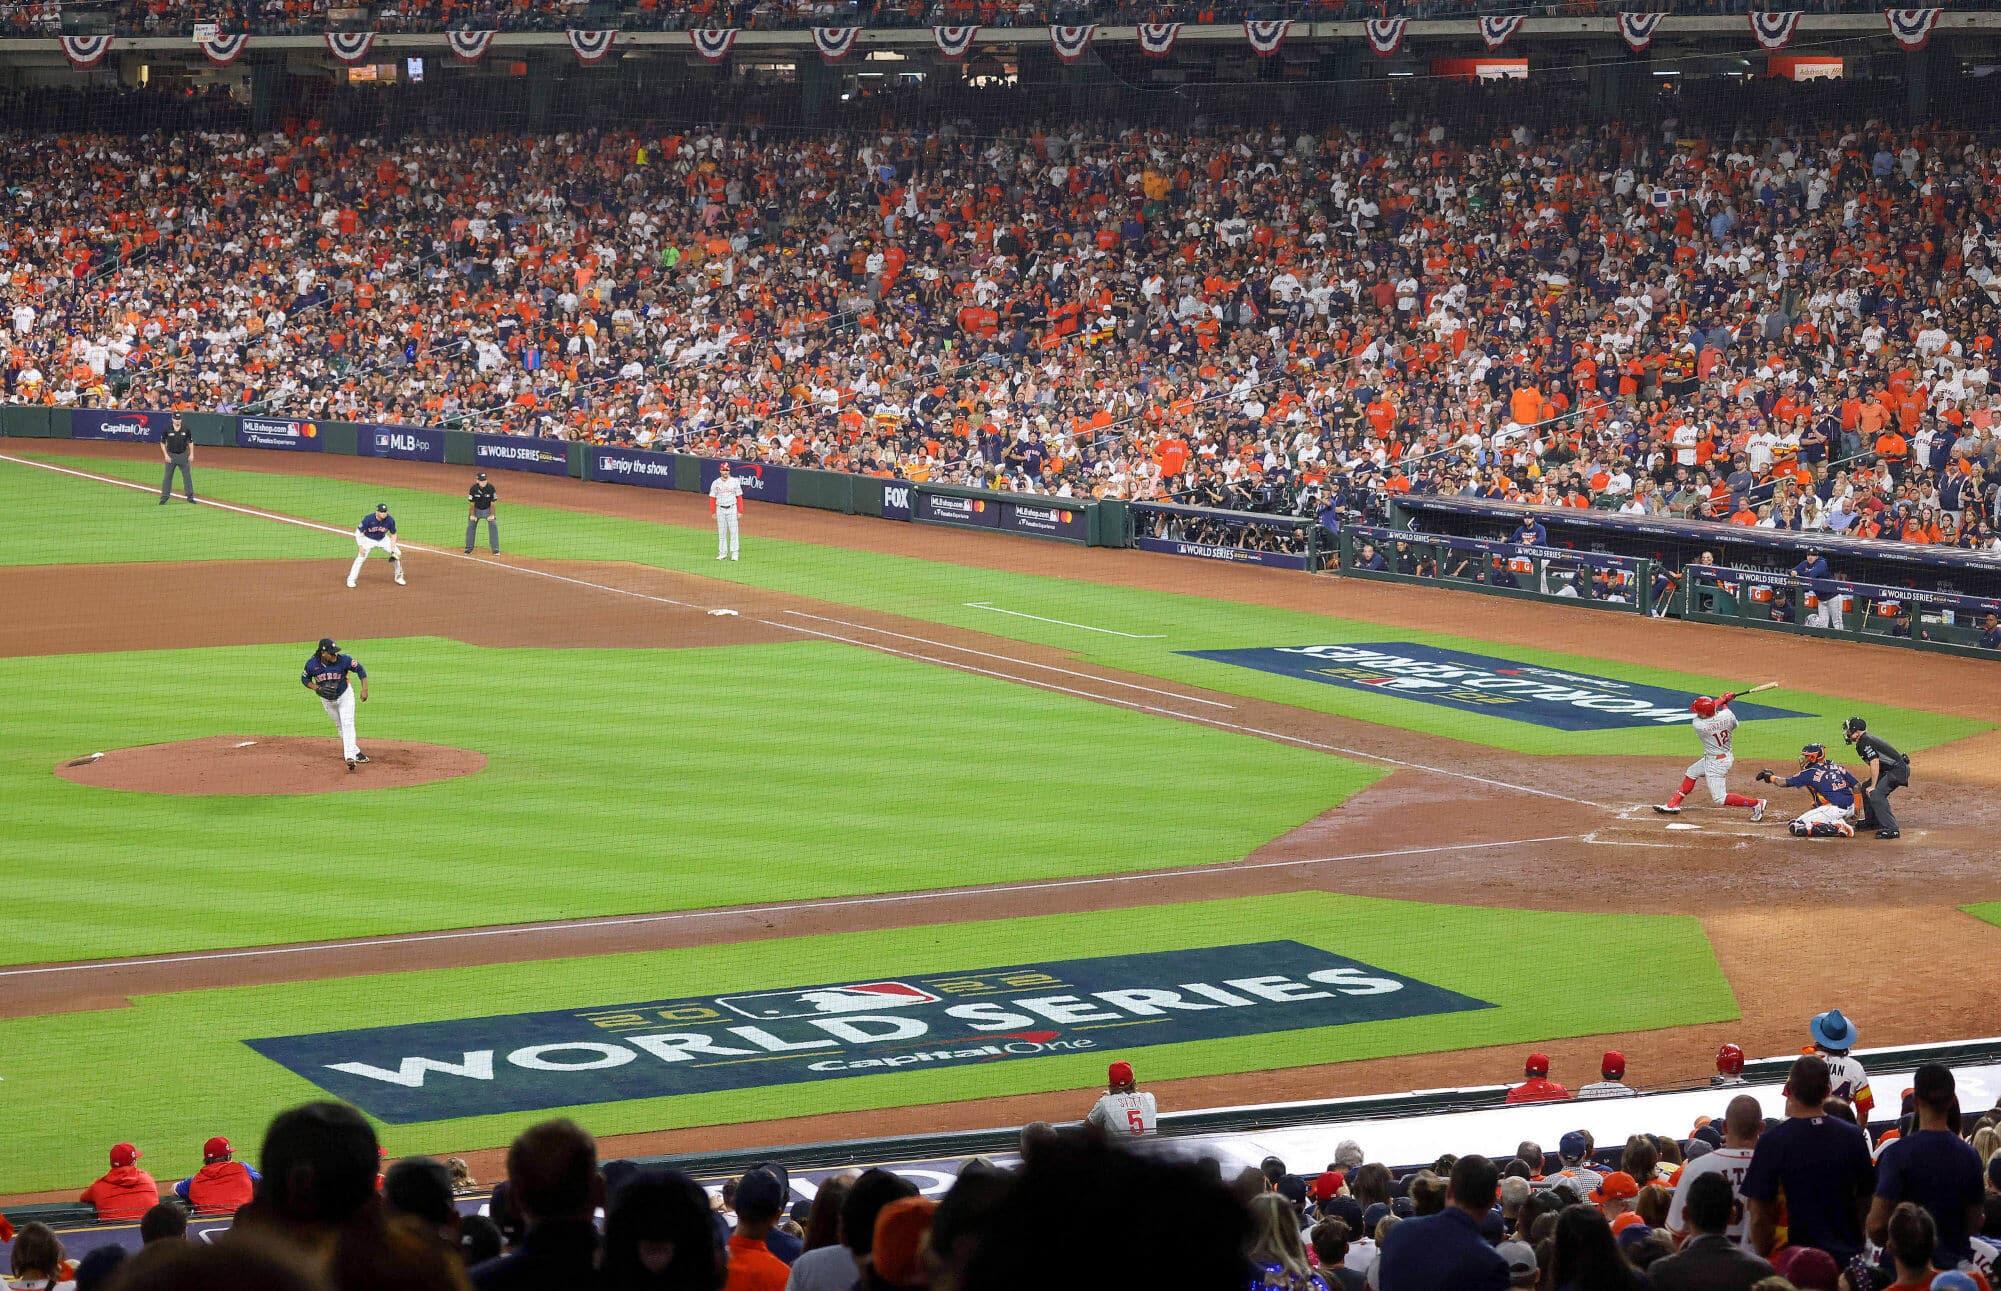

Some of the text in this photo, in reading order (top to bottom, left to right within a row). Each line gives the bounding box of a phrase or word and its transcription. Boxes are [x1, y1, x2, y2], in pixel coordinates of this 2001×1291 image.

[100, 423, 151, 436] CapitalOne
[244, 422, 287, 434] MLBshop.com
[390, 434, 430, 452] MLB App
[488, 445, 516, 459] WORLD
[516, 448, 540, 461] SERIES
[612, 458, 668, 476] enjoy the show.
[884, 486, 909, 509] FOX
[1394, 532, 1412, 541] WORLD
[1412, 534, 1430, 543] SERIES
[1186, 544, 1212, 557] WORLD
[1211, 547, 1234, 560] SERIES
[1521, 548, 1543, 557] WORLD
[1543, 550, 1562, 559] SERIES
[1510, 561, 1517, 570] G
[1523, 562, 1530, 571] G
[1744, 573, 1768, 583] WORLD
[1768, 575, 1788, 585] SERIES
[1754, 590, 1761, 599] G
[1888, 590, 1912, 600] WORLD
[1912, 592, 1933, 602] SERIES
[1880, 605, 1887, 614] G
[1712, 729, 1729, 747] 12
[320, 967, 1404, 1089] WORLD SERIES
[807, 1037, 1097, 1072] CapitalOne
[1127, 1109, 1145, 1137] 5
